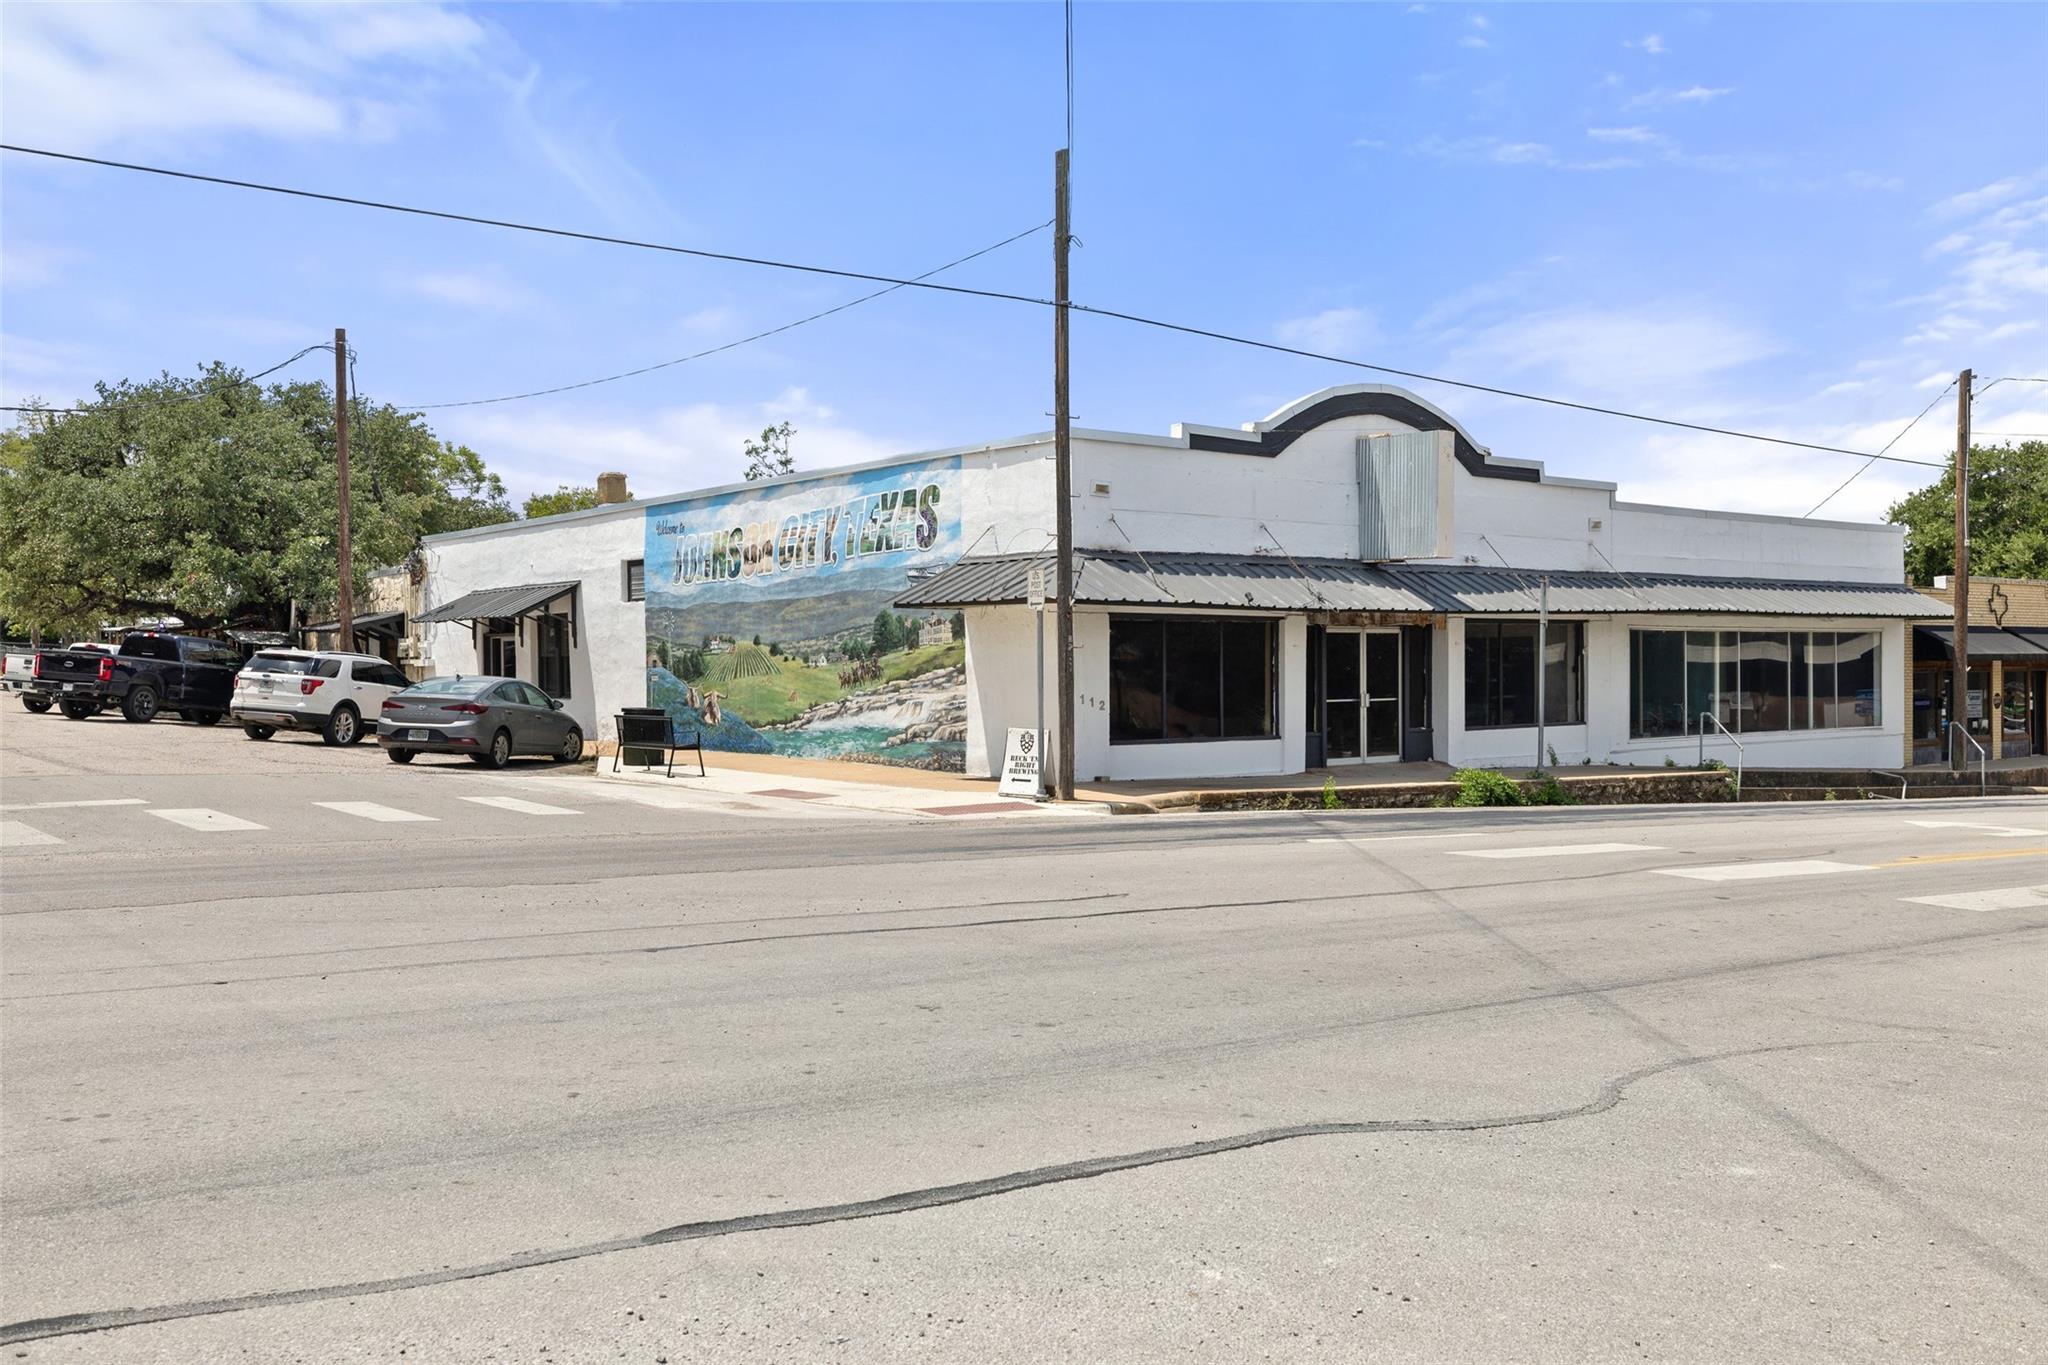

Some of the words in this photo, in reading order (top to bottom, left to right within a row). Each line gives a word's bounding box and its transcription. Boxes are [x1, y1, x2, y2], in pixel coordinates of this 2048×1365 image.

[655, 519, 677, 536] Welcome
[672, 520, 777, 586] JOHNSON
[778, 504, 842, 571] CITY,
[843, 483, 941, 559] TEXAS
[1079, 693, 1106, 711] 112
